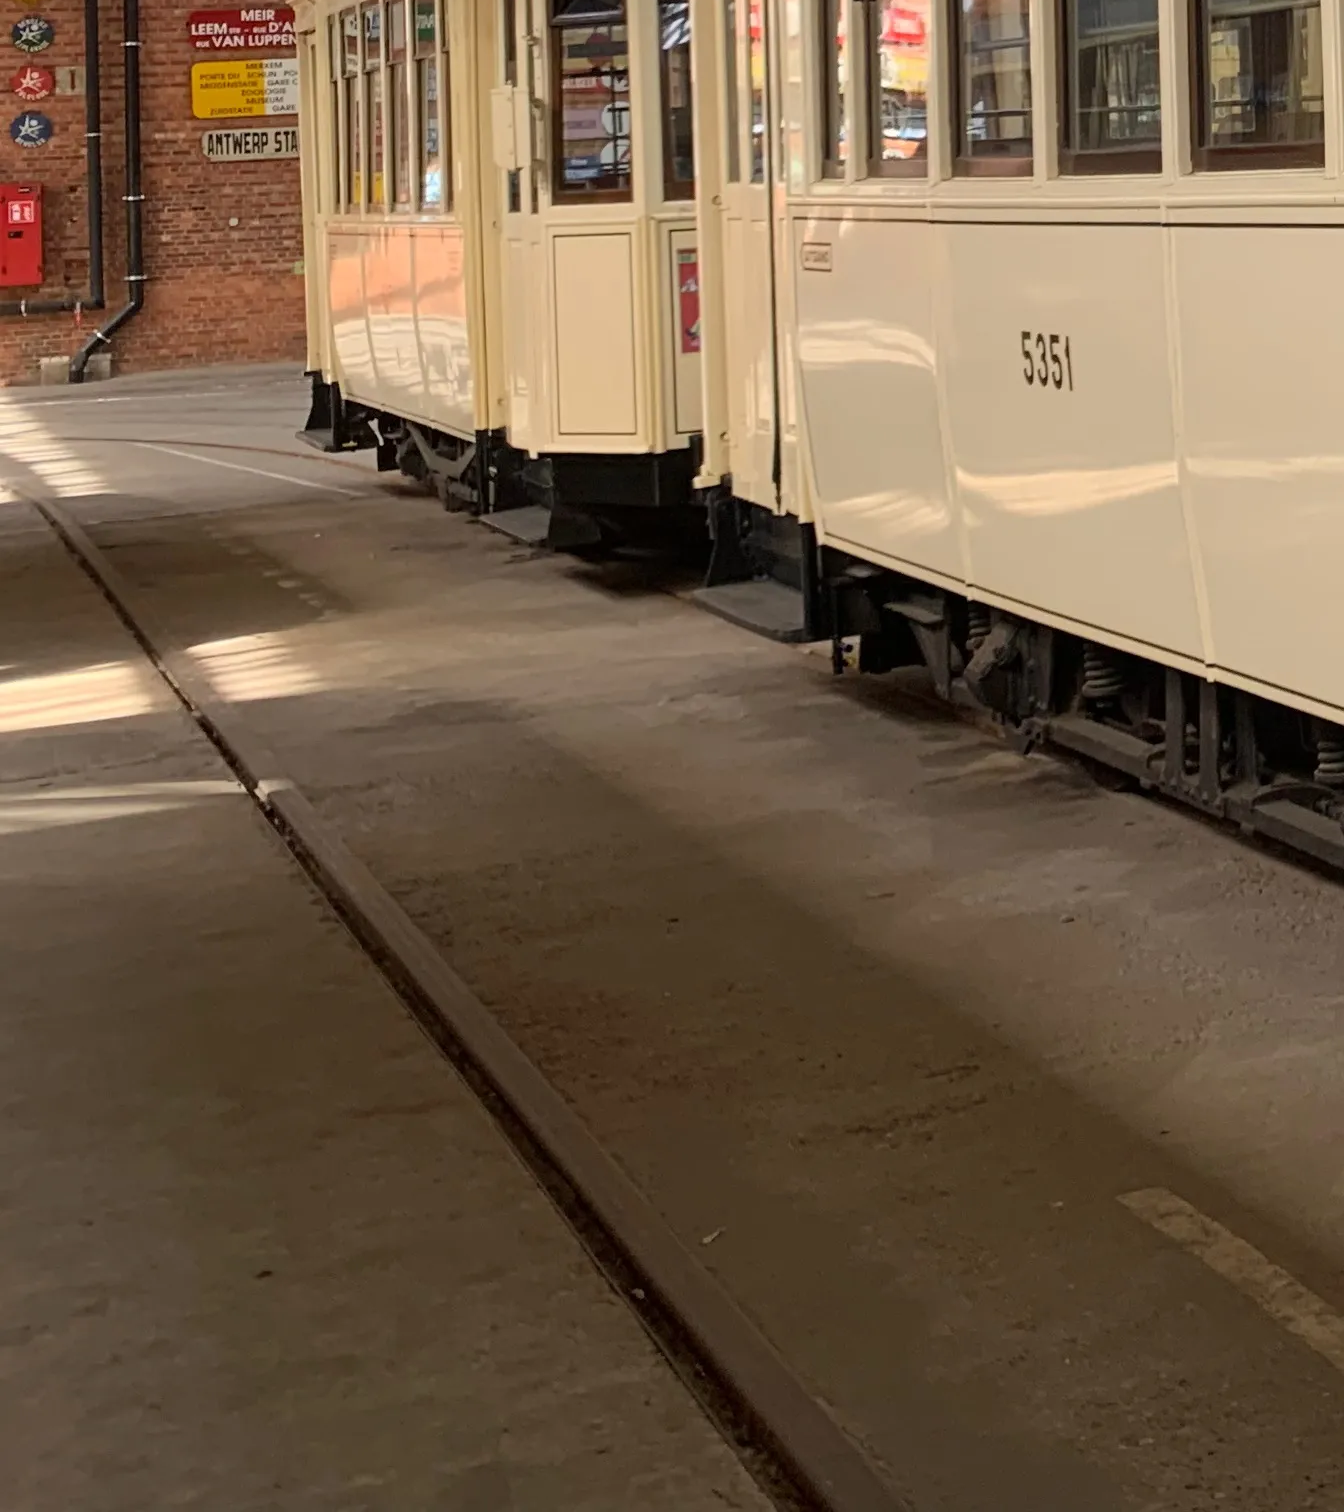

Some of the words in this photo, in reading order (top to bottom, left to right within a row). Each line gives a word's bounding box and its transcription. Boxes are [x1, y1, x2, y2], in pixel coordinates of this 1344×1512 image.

[240, 9, 275, 21] MEIR
[268, 21, 296, 33] D'A
[212, 36, 245, 47] VAN
[248, 34, 297, 47] LUPPEN
[267, 79, 290, 87] GARE
[246, 96, 284, 104] MUSEUM
[207, 132, 269, 156] ANTWERP
[1021, 331, 1074, 392] 5351
